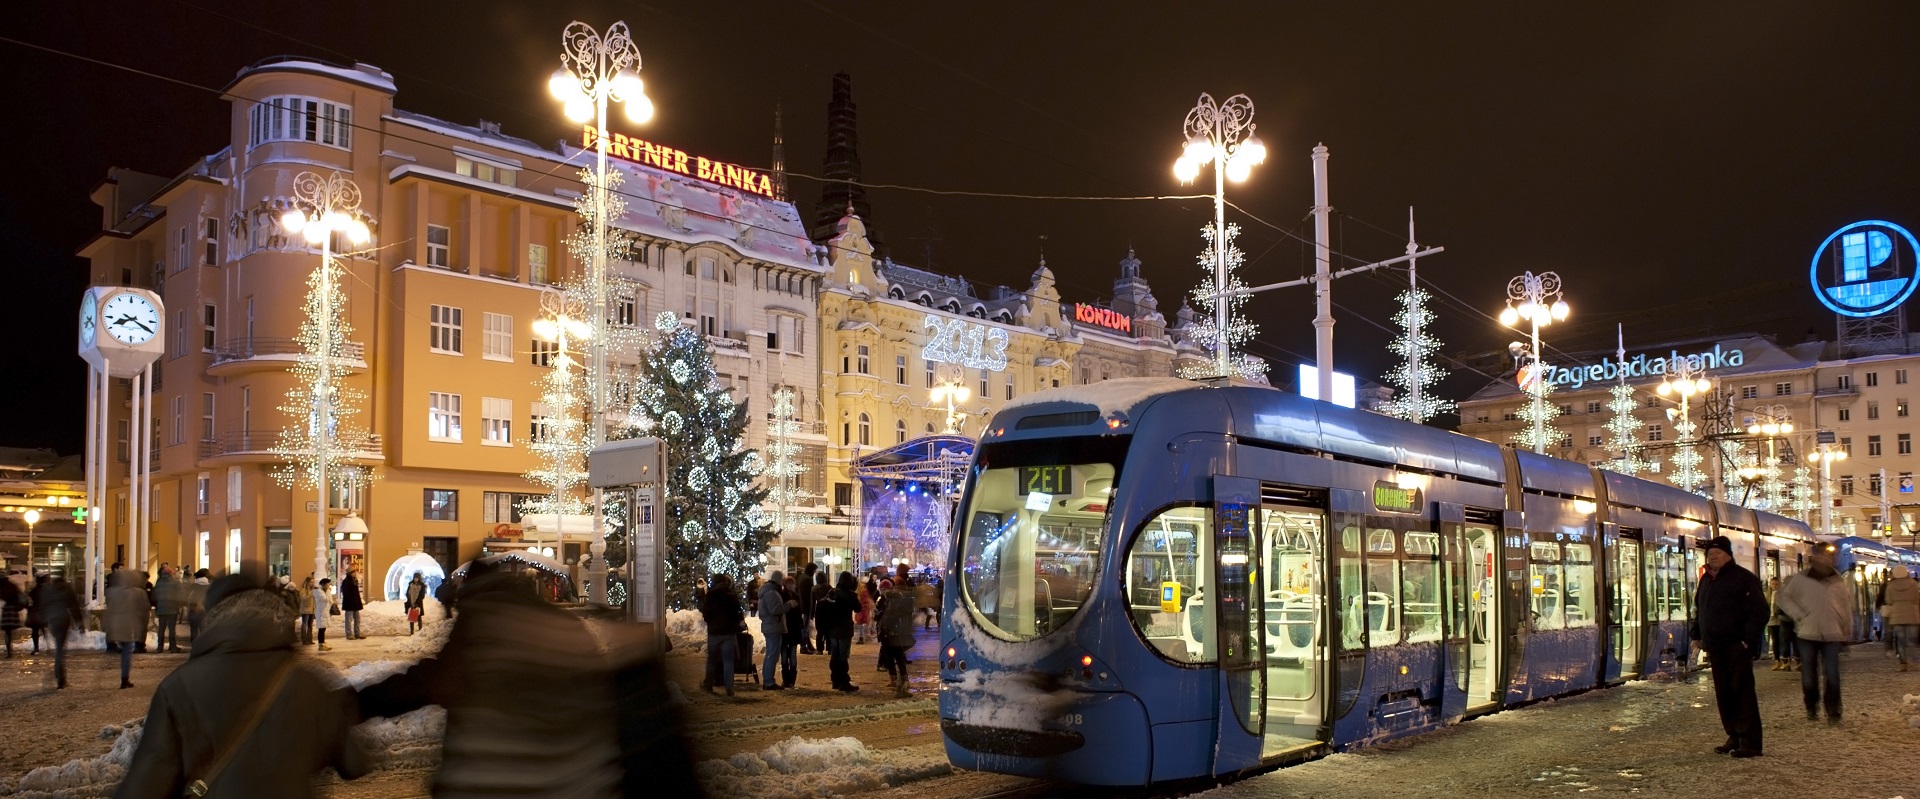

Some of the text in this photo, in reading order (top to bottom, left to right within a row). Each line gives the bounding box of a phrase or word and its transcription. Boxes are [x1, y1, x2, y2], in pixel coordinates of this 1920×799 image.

[583, 124, 774, 197] PARTNER BANKA
[1075, 303, 1130, 332] KONZUM
[921, 314, 1009, 372] 2013
[1547, 344, 1744, 389] Zagrebačka banka
[1027, 466, 1066, 493] ZET
